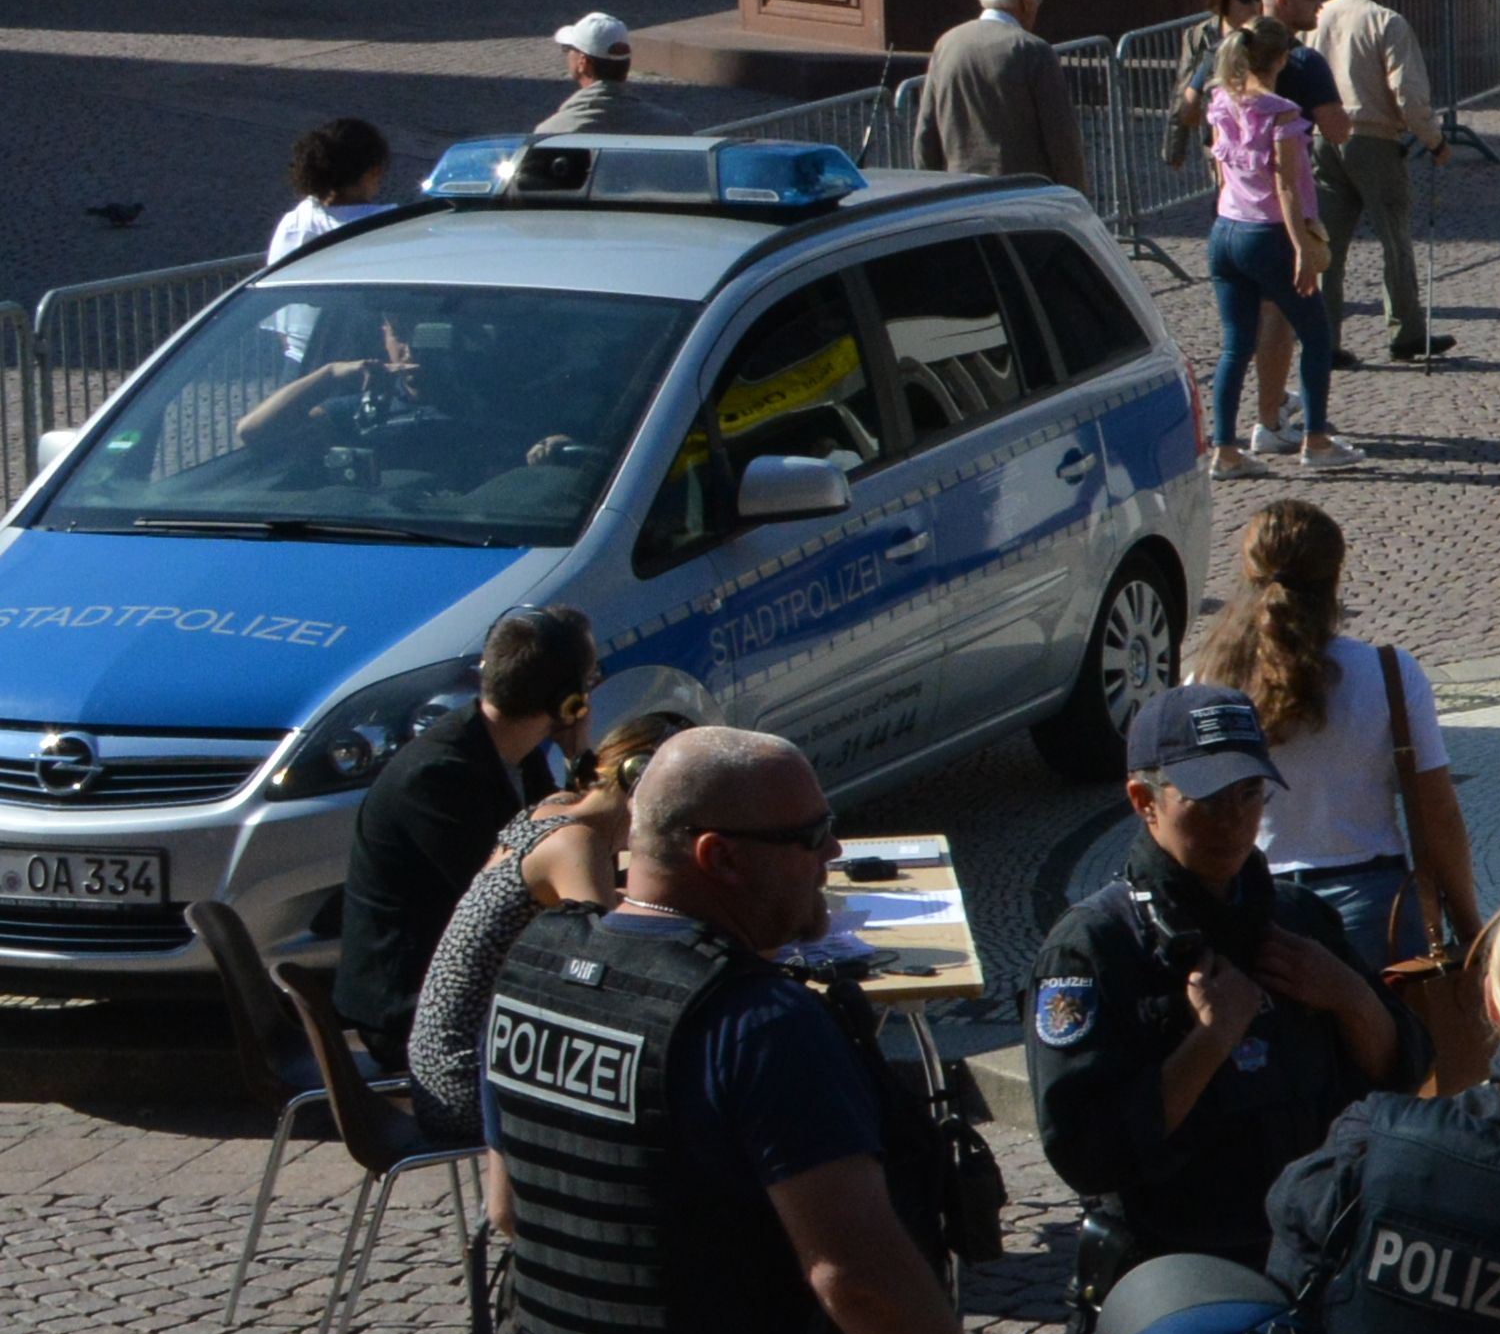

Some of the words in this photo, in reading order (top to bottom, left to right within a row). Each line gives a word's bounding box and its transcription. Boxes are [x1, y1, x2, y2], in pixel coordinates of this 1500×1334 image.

[708, 549, 883, 667] STADTPOLIZEI
[27, 854, 75, 895] OA
[84, 857, 156, 898] 334
[1040, 976, 1094, 990] POLIZEI
[491, 1013, 633, 1105] POLIZEI
